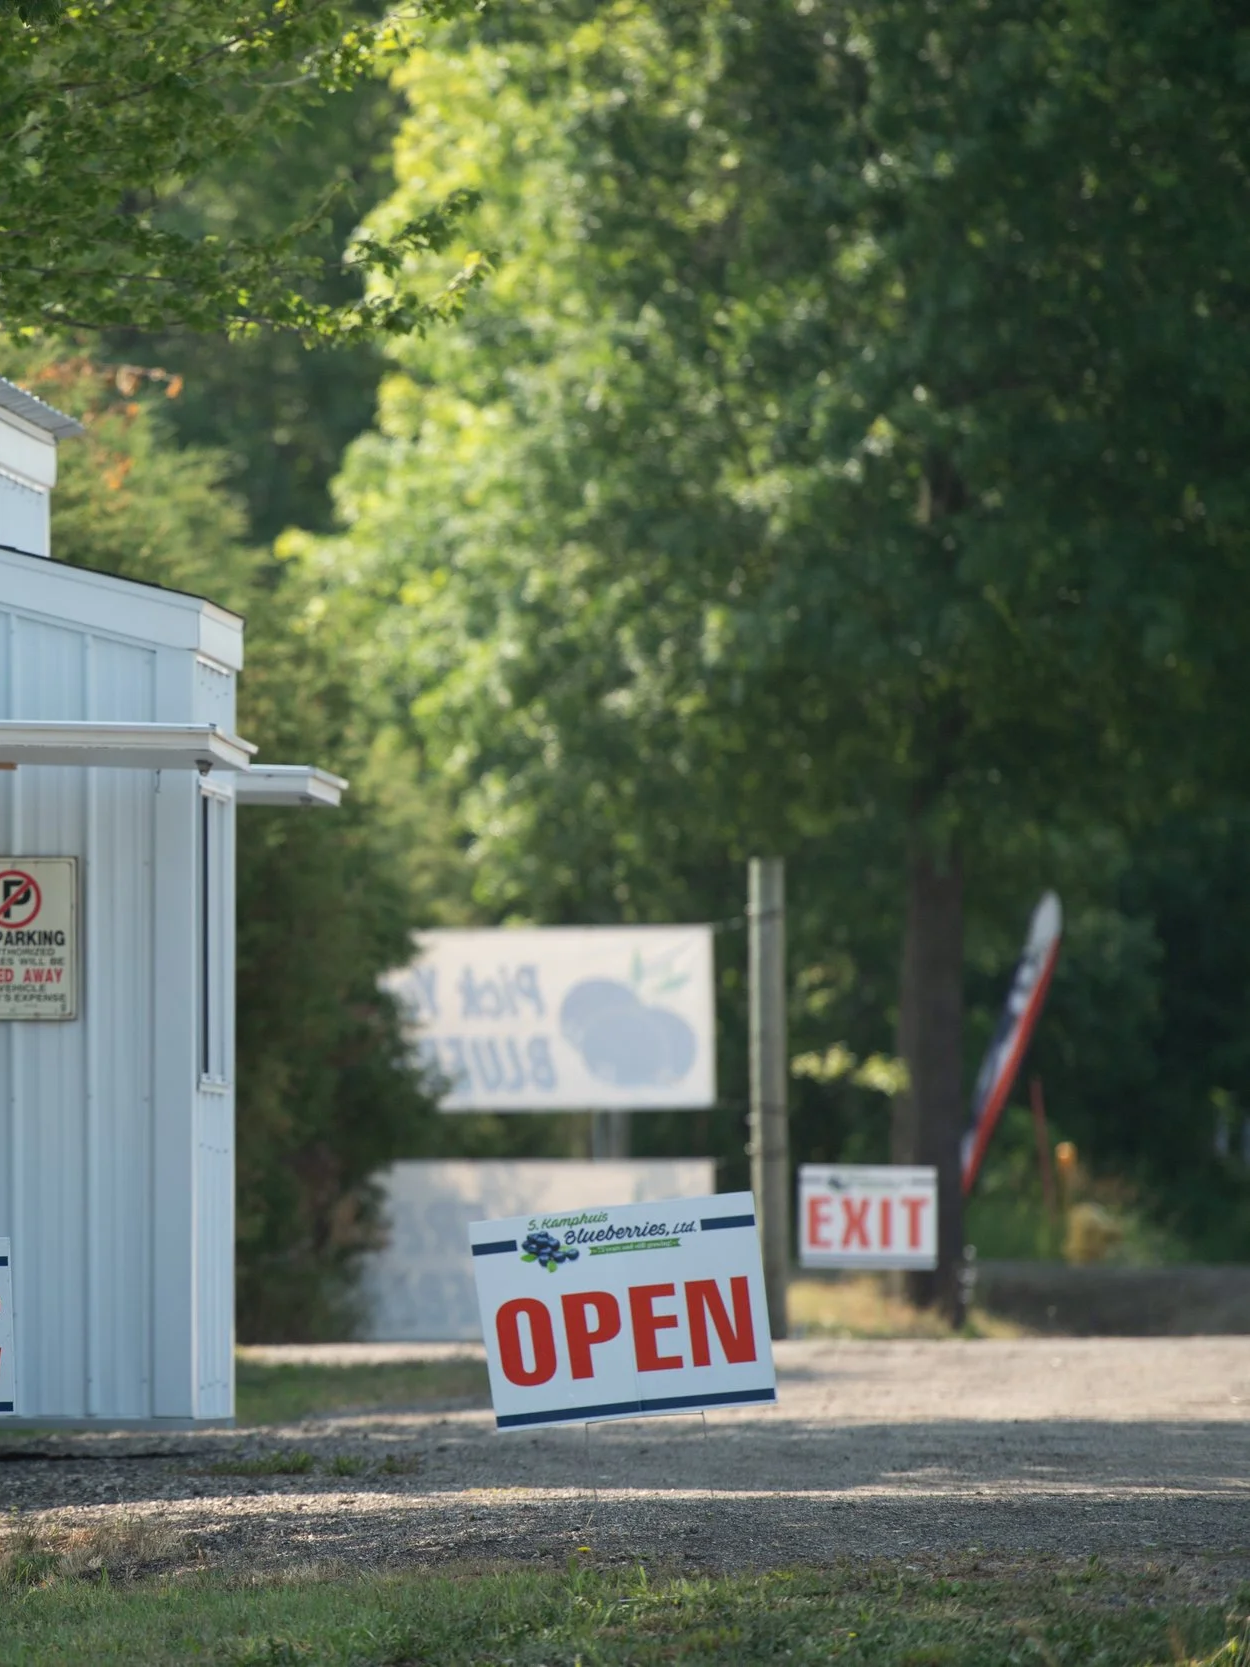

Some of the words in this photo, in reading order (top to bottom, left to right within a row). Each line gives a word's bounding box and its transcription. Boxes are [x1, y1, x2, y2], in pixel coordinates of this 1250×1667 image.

[19, 957, 45, 966] WILL
[50, 957, 65, 966] BE
[23, 968, 64, 983] AWAY
[14, 993, 66, 1002] EXPENSE
[527, 1218, 539, 1231] S.
[541, 1212, 608, 1230] Kamphuis
[807, 1195, 930, 1249] EXIT
[563, 1221, 670, 1246] Blueberries,
[672, 1220, 698, 1235] Ltd.
[495, 1275, 757, 1387] OPEN
